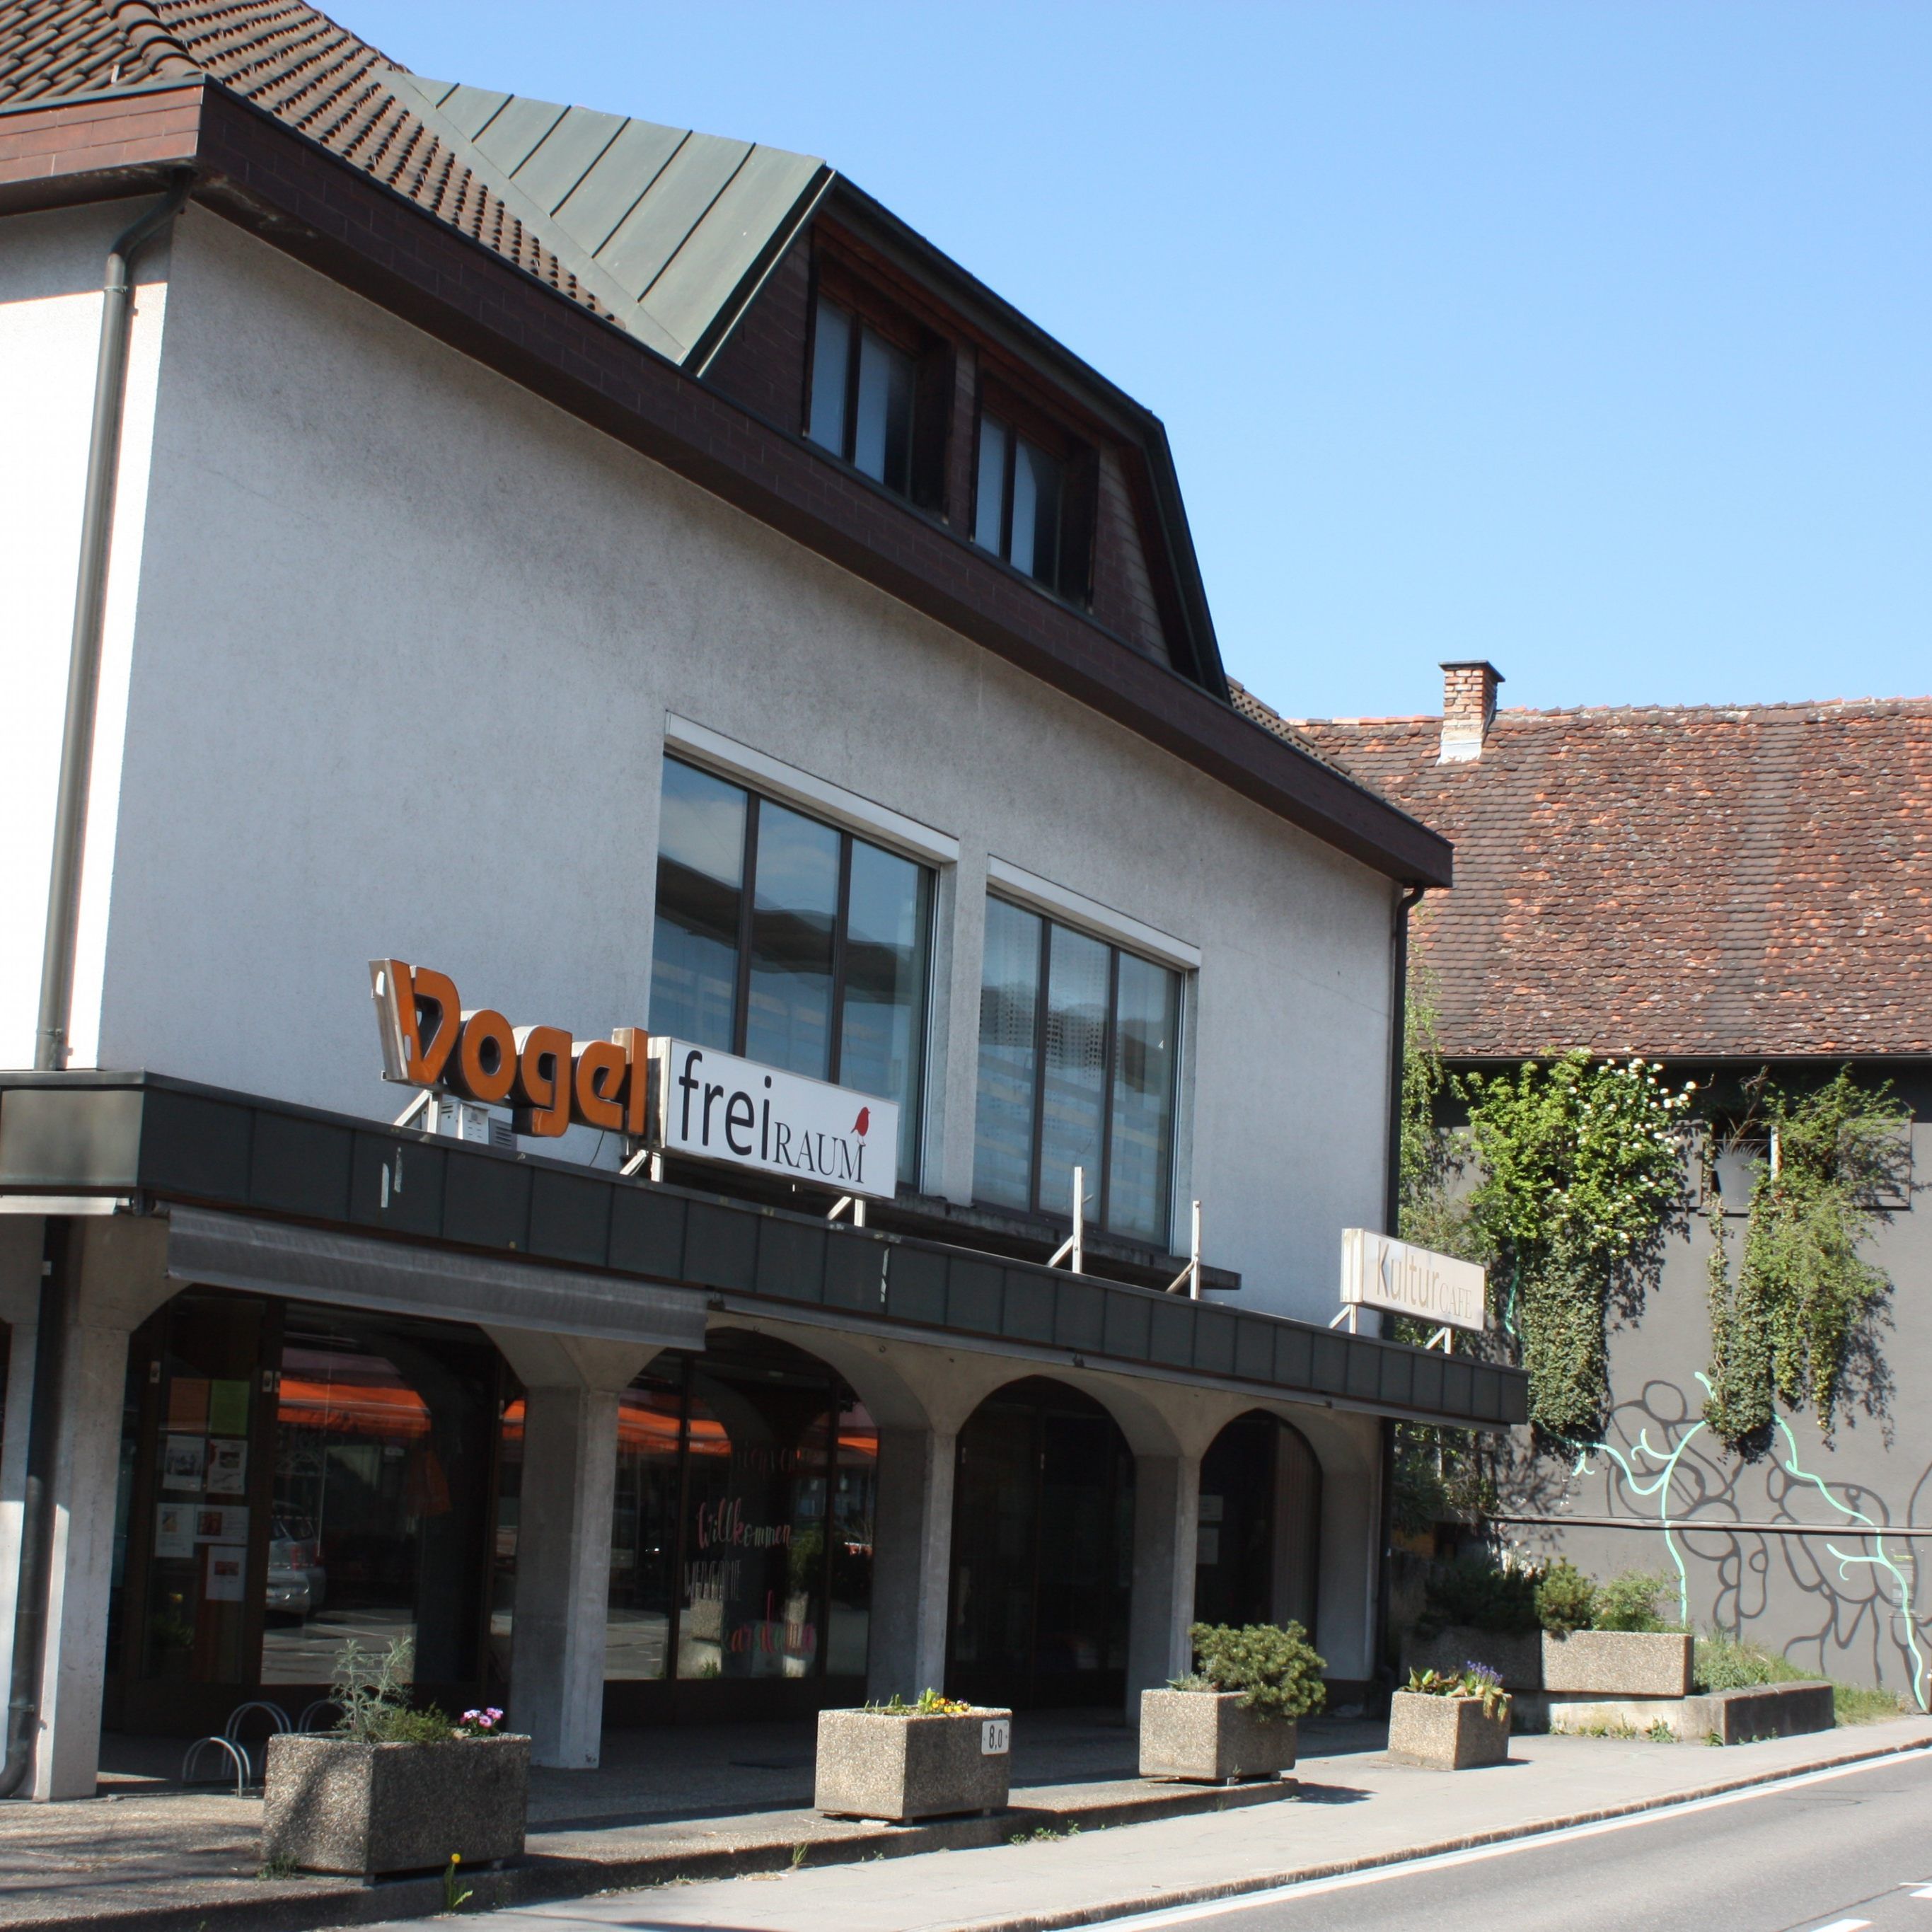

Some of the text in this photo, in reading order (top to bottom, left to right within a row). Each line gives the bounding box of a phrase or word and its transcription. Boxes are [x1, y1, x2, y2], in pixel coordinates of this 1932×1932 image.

[381, 959, 648, 1138] Vogel
[678, 1050, 864, 1185] freiRAUM
[696, 1497, 792, 1550] Willkommen
[989, 1724, 1003, 1750] 8,0
